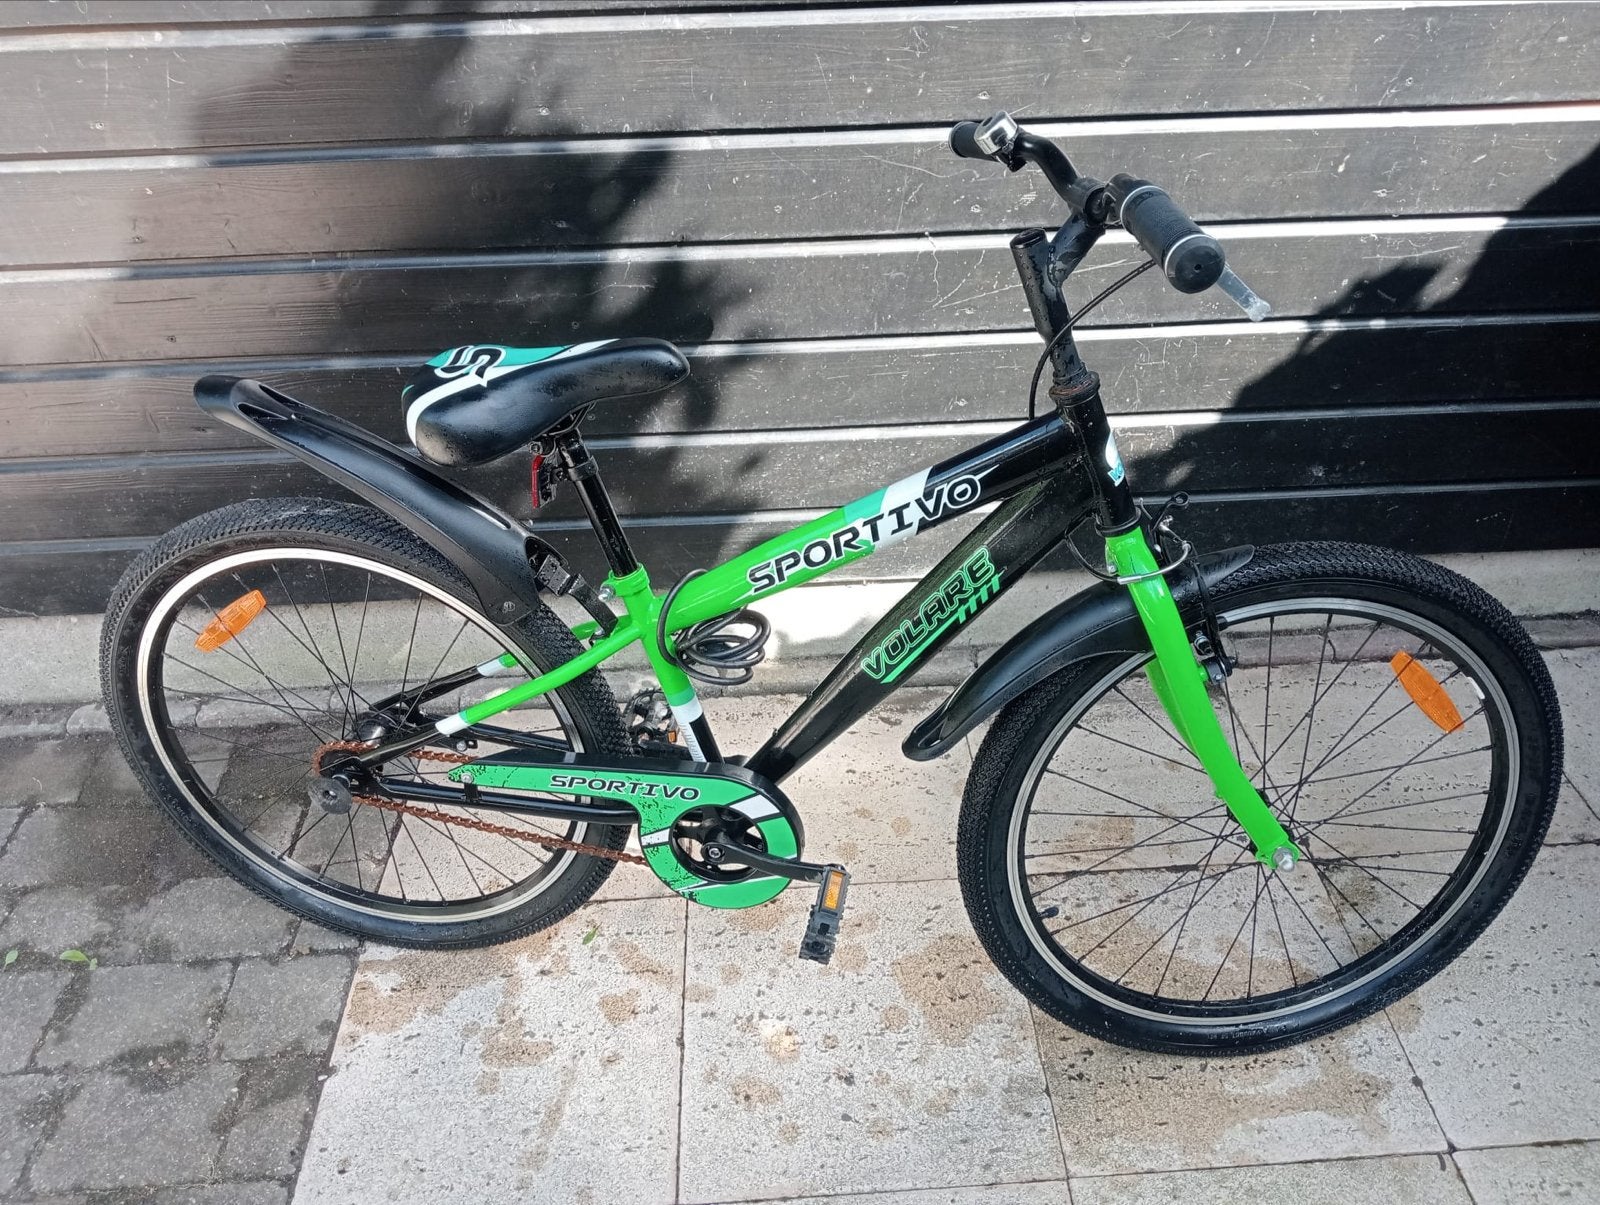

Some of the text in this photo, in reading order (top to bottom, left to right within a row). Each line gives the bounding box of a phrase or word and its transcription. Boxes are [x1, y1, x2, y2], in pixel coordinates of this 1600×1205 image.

[746, 474, 981, 593] SPORTIVO
[861, 546, 995, 679] VOLARE
[550, 775, 701, 801] SPORTIVO
